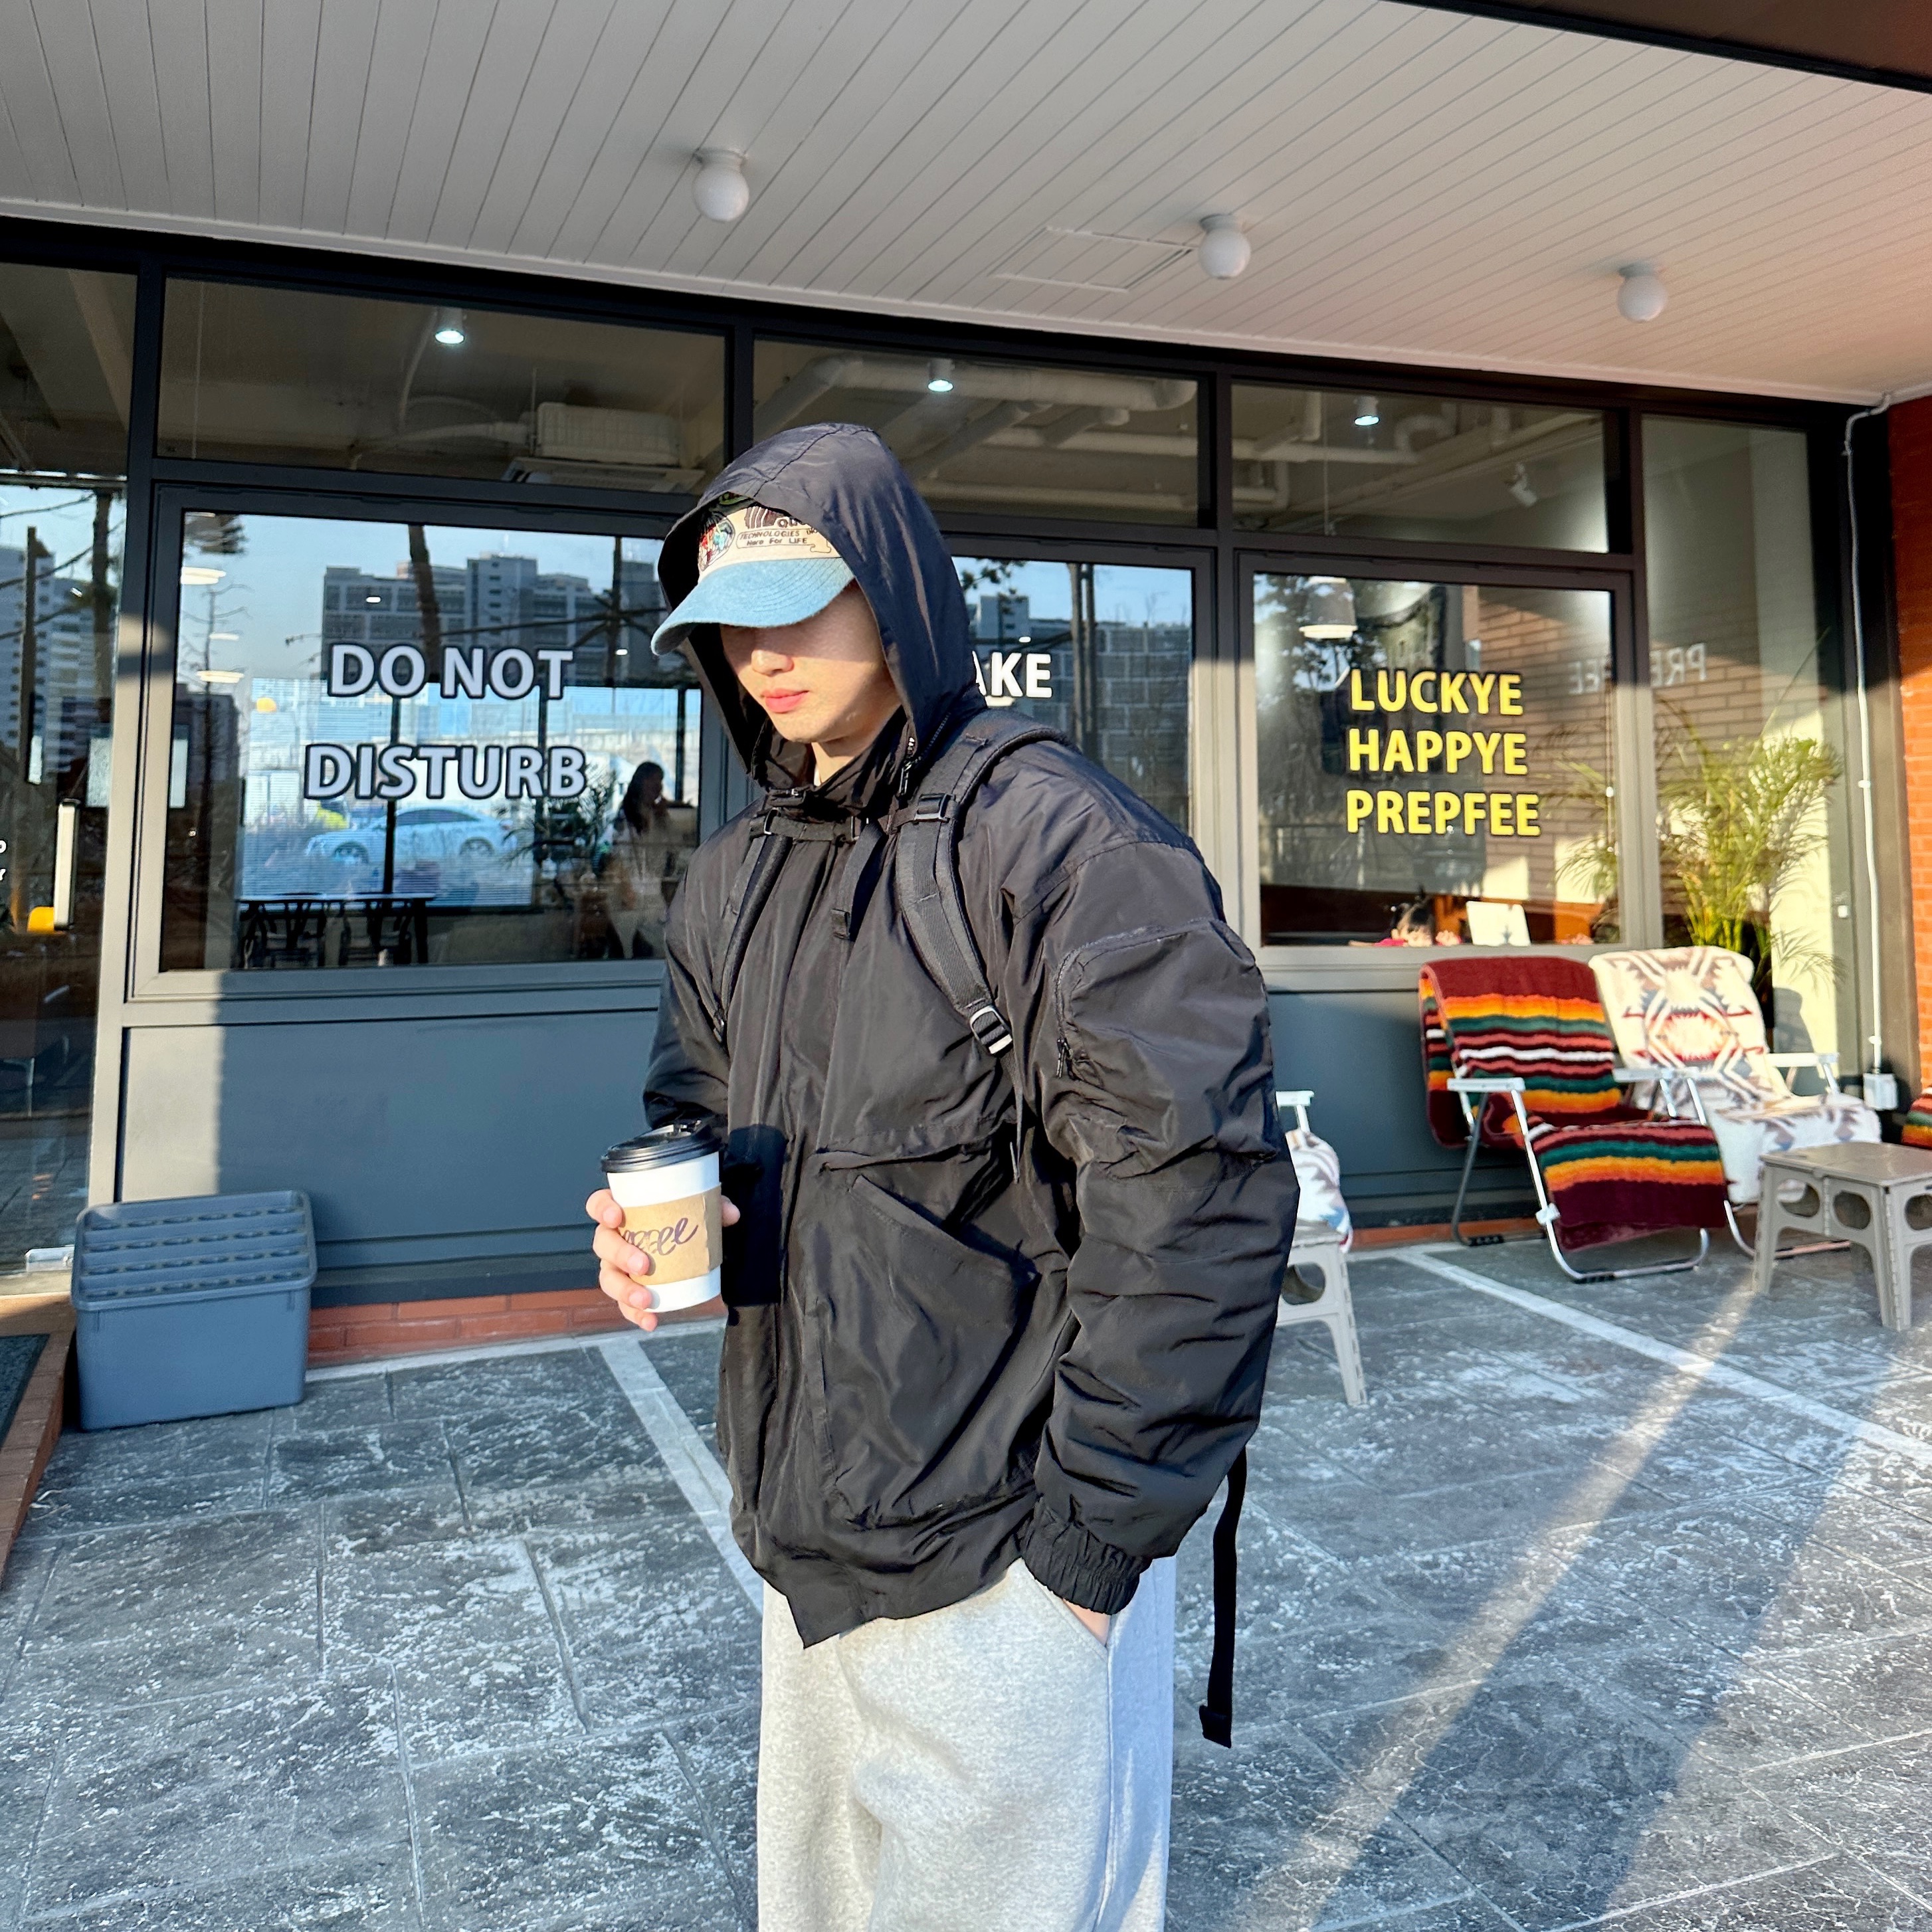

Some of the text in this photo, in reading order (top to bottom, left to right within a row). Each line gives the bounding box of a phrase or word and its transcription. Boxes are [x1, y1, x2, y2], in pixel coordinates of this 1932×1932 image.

[330, 643, 575, 699] DO NOT
[1351, 668, 1523, 716] LUCKYE
[306, 744, 586, 799] DISTURB
[1349, 728, 1528, 775] HAPPYE
[1346, 789, 1541, 836] PREPFEE
